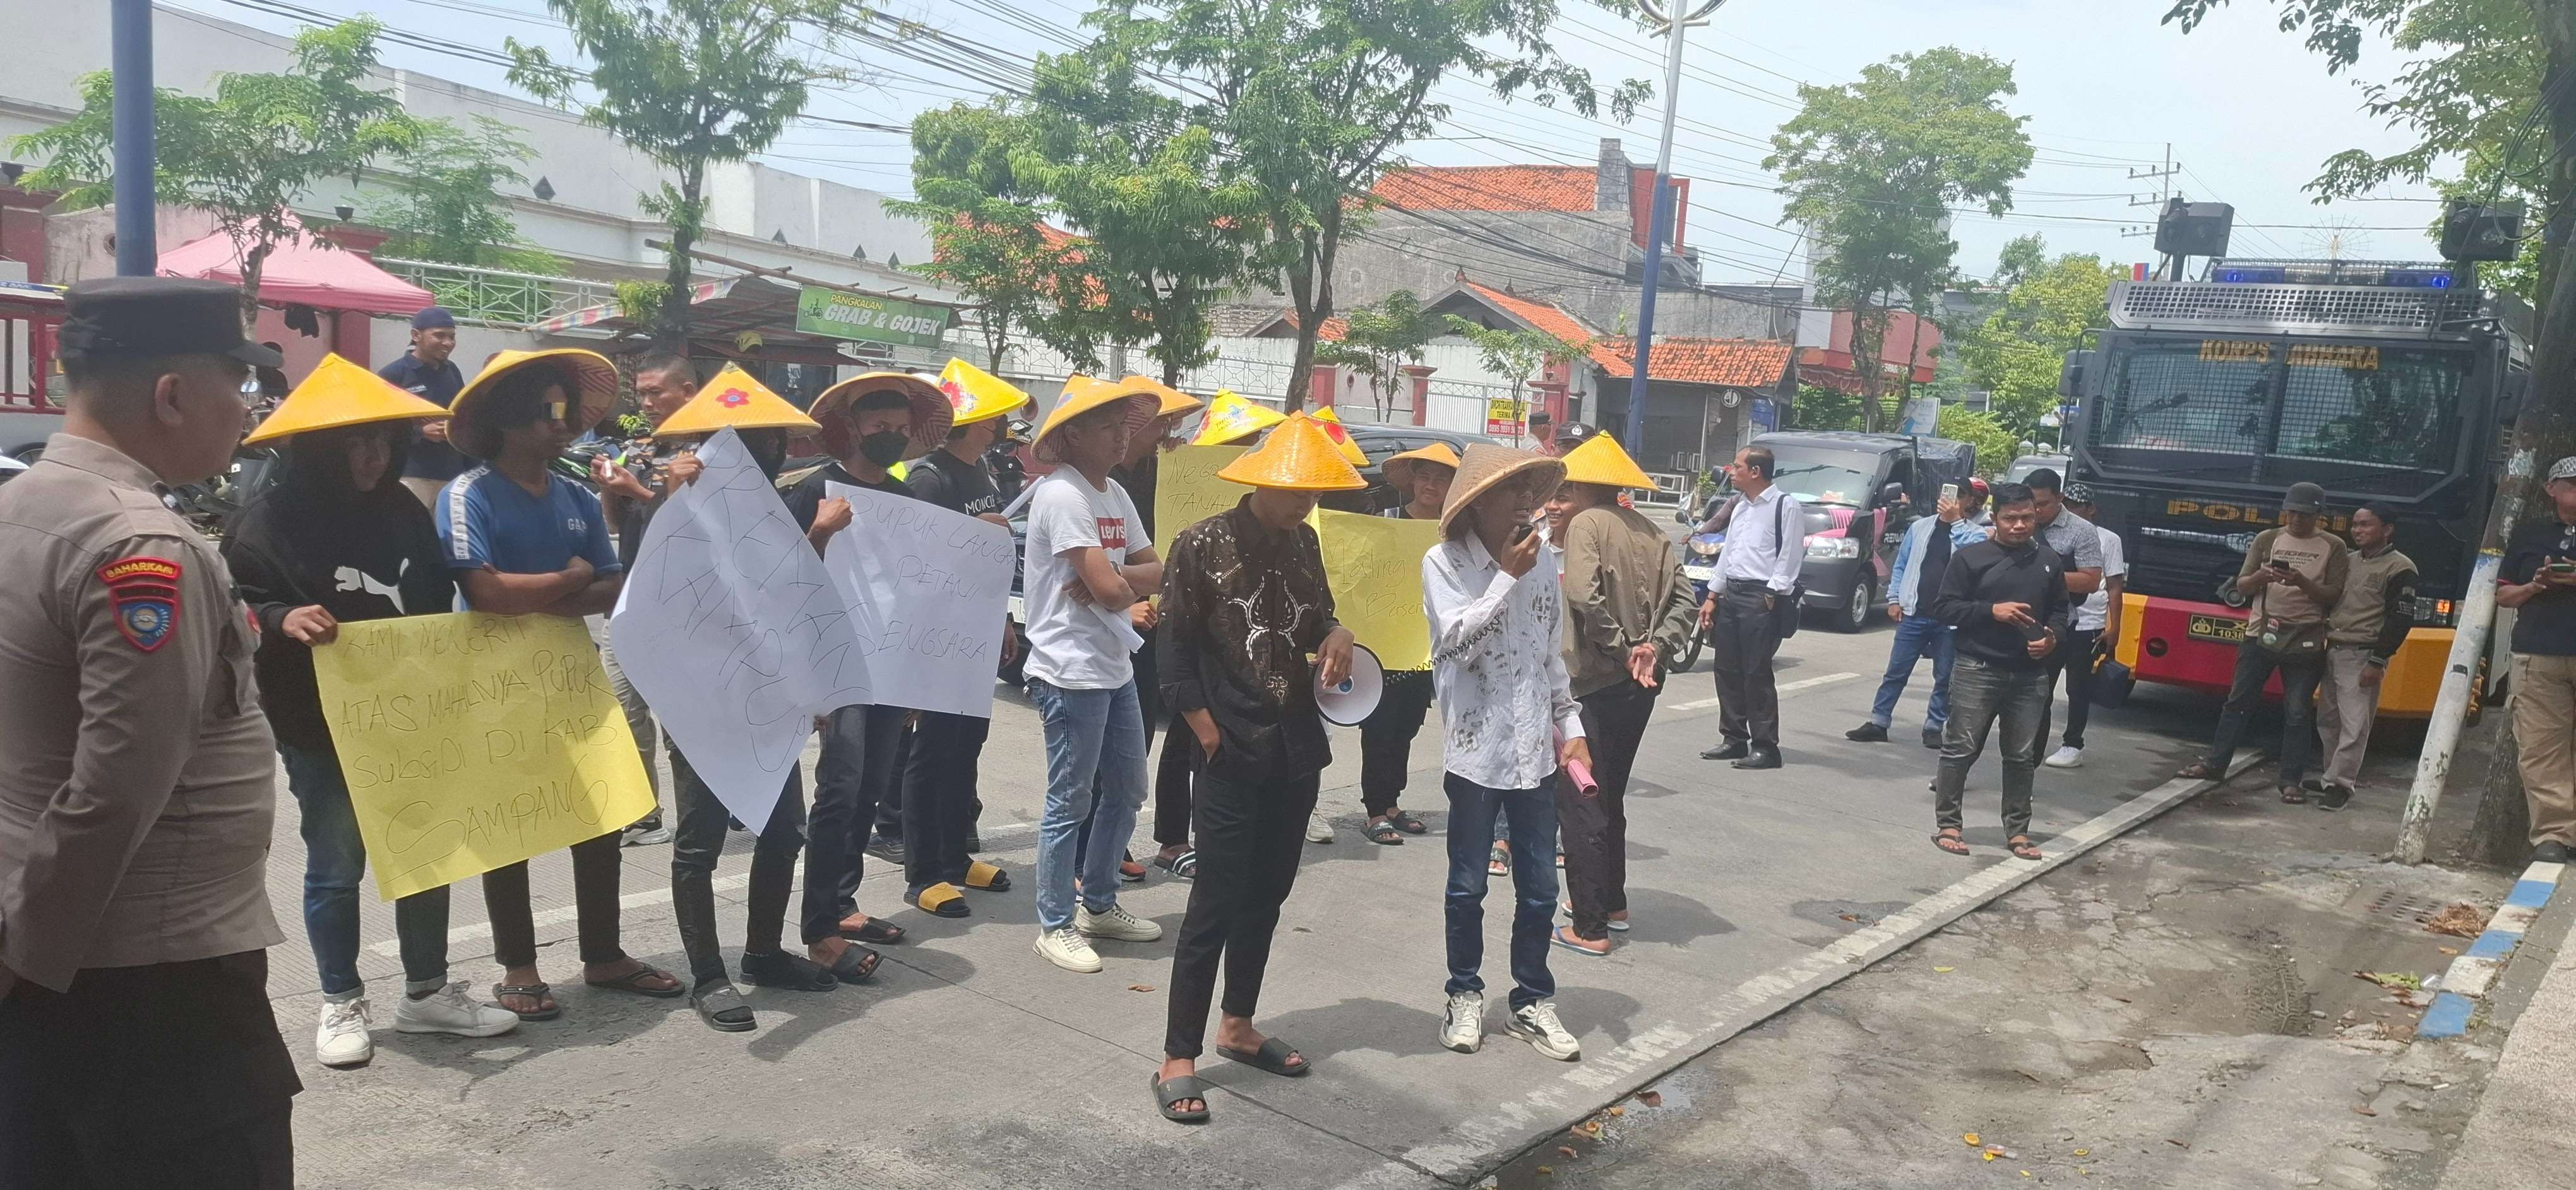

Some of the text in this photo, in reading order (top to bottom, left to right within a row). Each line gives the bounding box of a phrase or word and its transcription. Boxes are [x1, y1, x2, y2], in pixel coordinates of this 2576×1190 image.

[823, 304, 941, 336] GRAB & GOJEK
[830, 294, 883, 311] PANGKALAN
[894, 555, 981, 601] PETANI
[343, 623, 400, 661] KAMI
[340, 694, 418, 743] ATAS
[532, 649, 619, 712] PUPUK
[485, 729, 526, 765] DI
[544, 714, 617, 755] KAB
